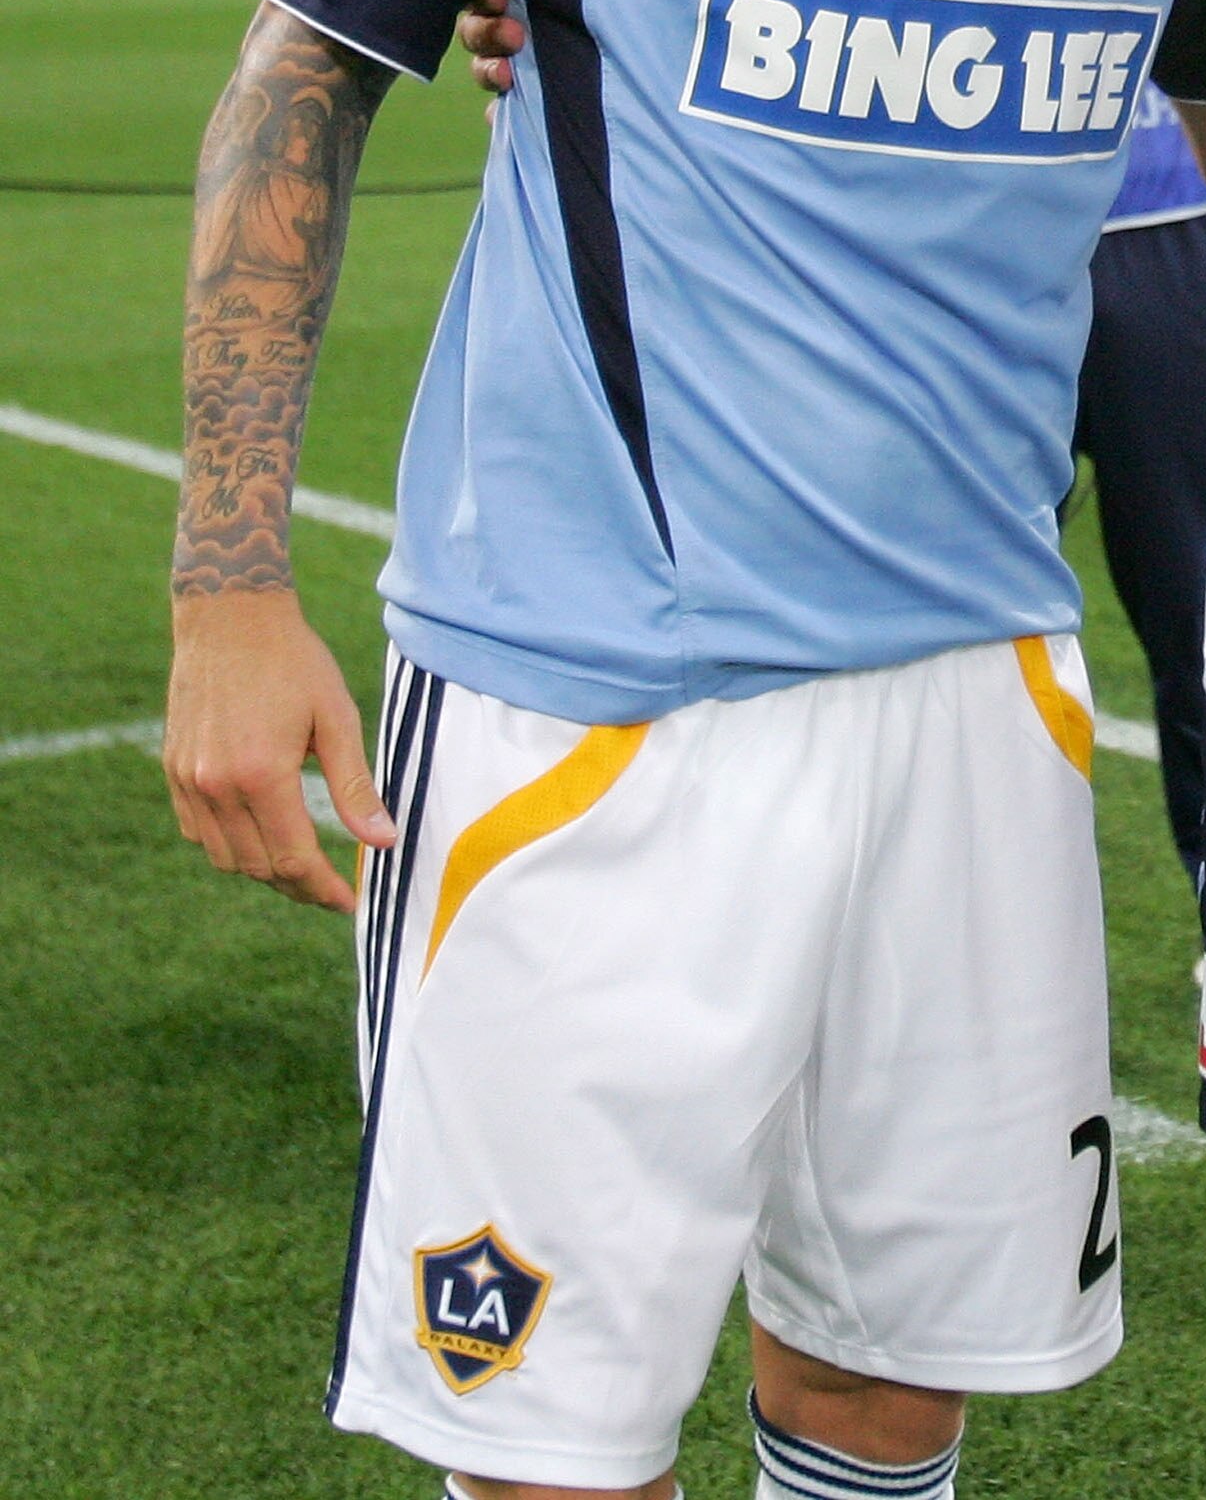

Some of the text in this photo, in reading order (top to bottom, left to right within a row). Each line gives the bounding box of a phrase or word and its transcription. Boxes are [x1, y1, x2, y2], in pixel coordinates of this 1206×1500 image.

[1020, 31, 1142, 133] LEE
[1070, 1115, 1118, 1294] 2
[430, 1332, 507, 1358] GALAXY
[438, 1279, 510, 1336] LA
